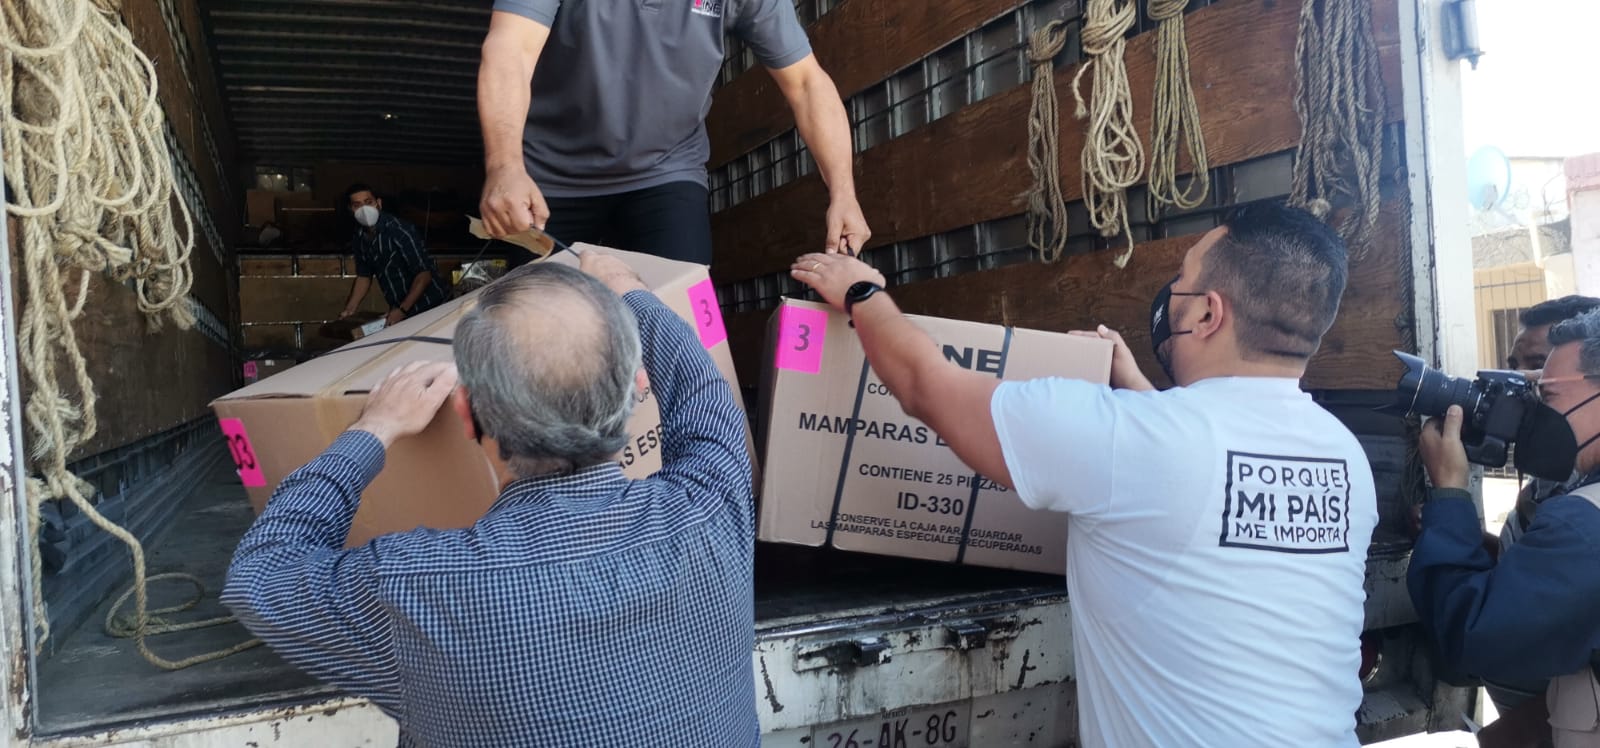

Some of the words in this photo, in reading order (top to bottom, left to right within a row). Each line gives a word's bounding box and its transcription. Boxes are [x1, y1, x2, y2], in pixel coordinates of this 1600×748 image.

[700, 299, 713, 327] 3
[794, 323, 811, 351] 3
[937, 343, 1002, 374] NE
[799, 411, 929, 444] MAMPARAS
[859, 463, 934, 484] CONTIENE
[937, 473, 953, 486] 25
[1238, 462, 1344, 488] PORQUE
[897, 491, 964, 516] ID-330
[1235, 490, 1276, 522] MI
[1287, 488, 1341, 524] PAÍS
[893, 519, 907, 529] LA
[909, 521, 937, 533] CAJA
[939, 524, 969, 536] PAR
[970, 528, 1023, 543] GUARDAR
[896, 530, 962, 545] ESPECIALES
[1235, 521, 1268, 540] ME
[1274, 525, 1341, 544] IMPORTA
